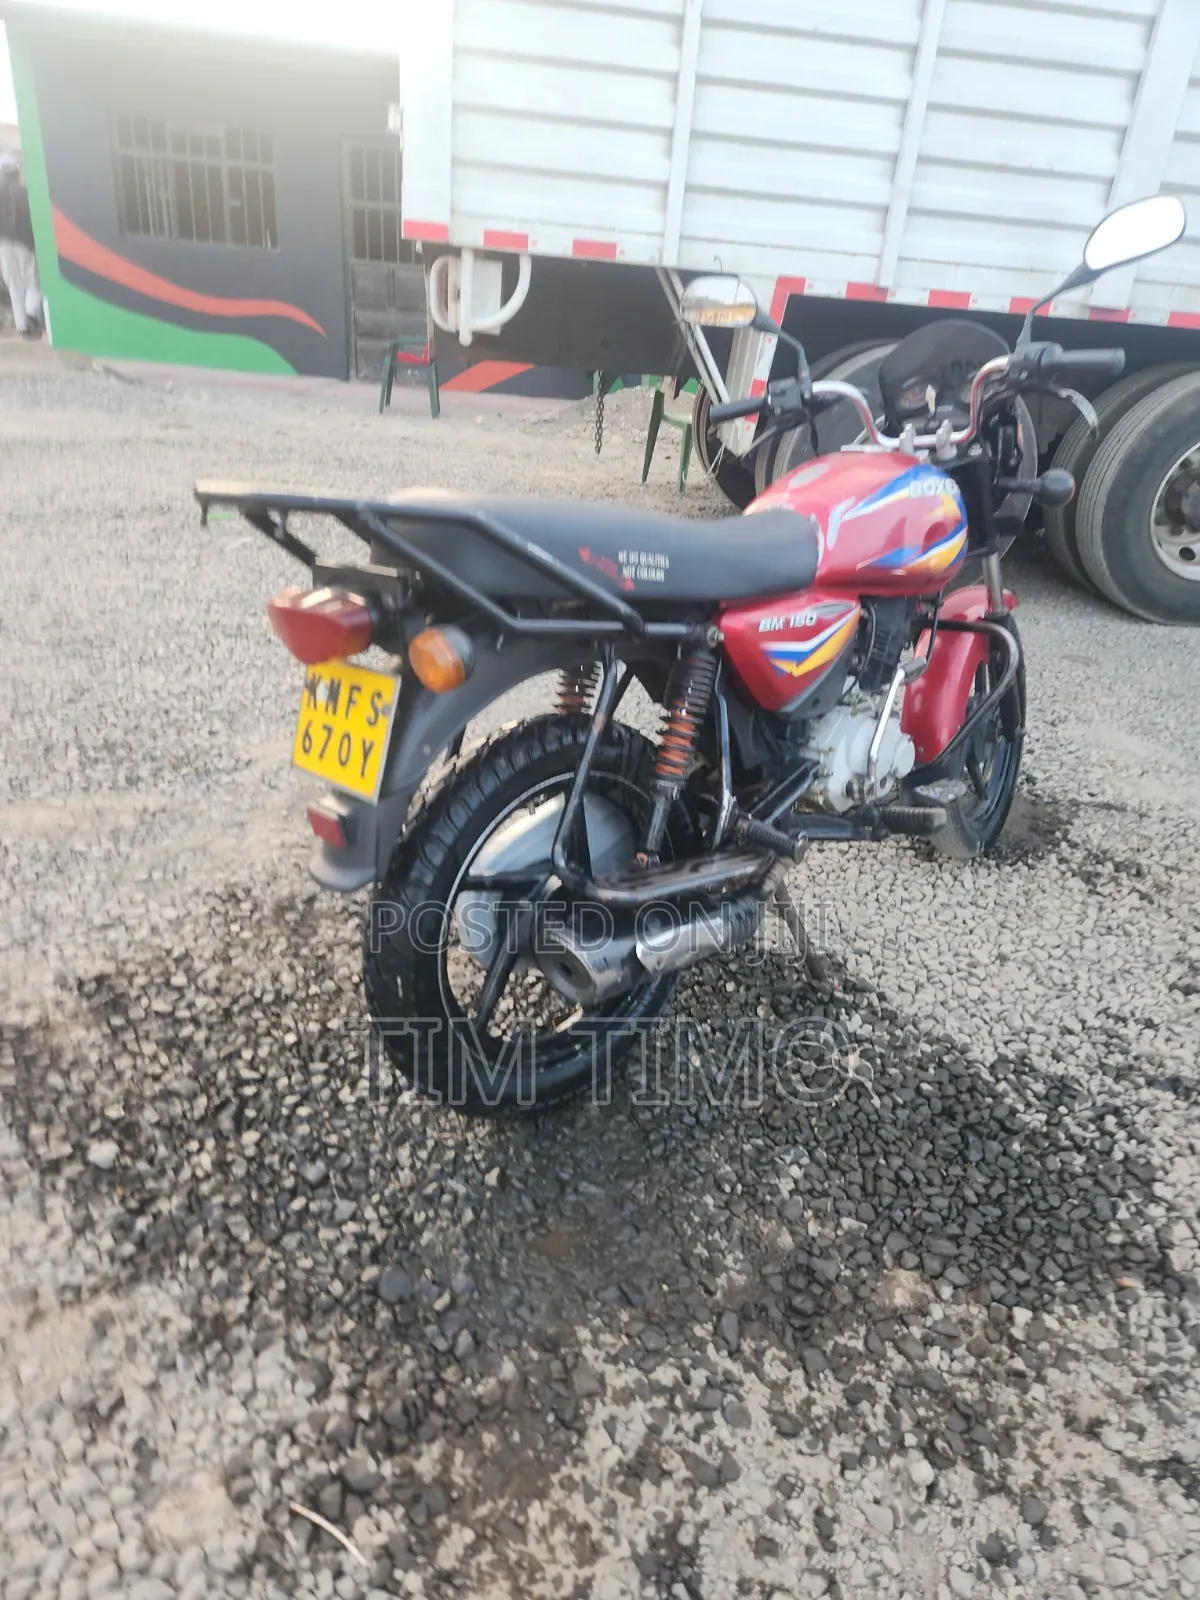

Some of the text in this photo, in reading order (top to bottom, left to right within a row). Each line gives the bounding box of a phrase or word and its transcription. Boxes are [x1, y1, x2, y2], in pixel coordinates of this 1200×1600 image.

[759, 611, 817, 632] BM 150
[301, 720, 375, 779] 670Y
